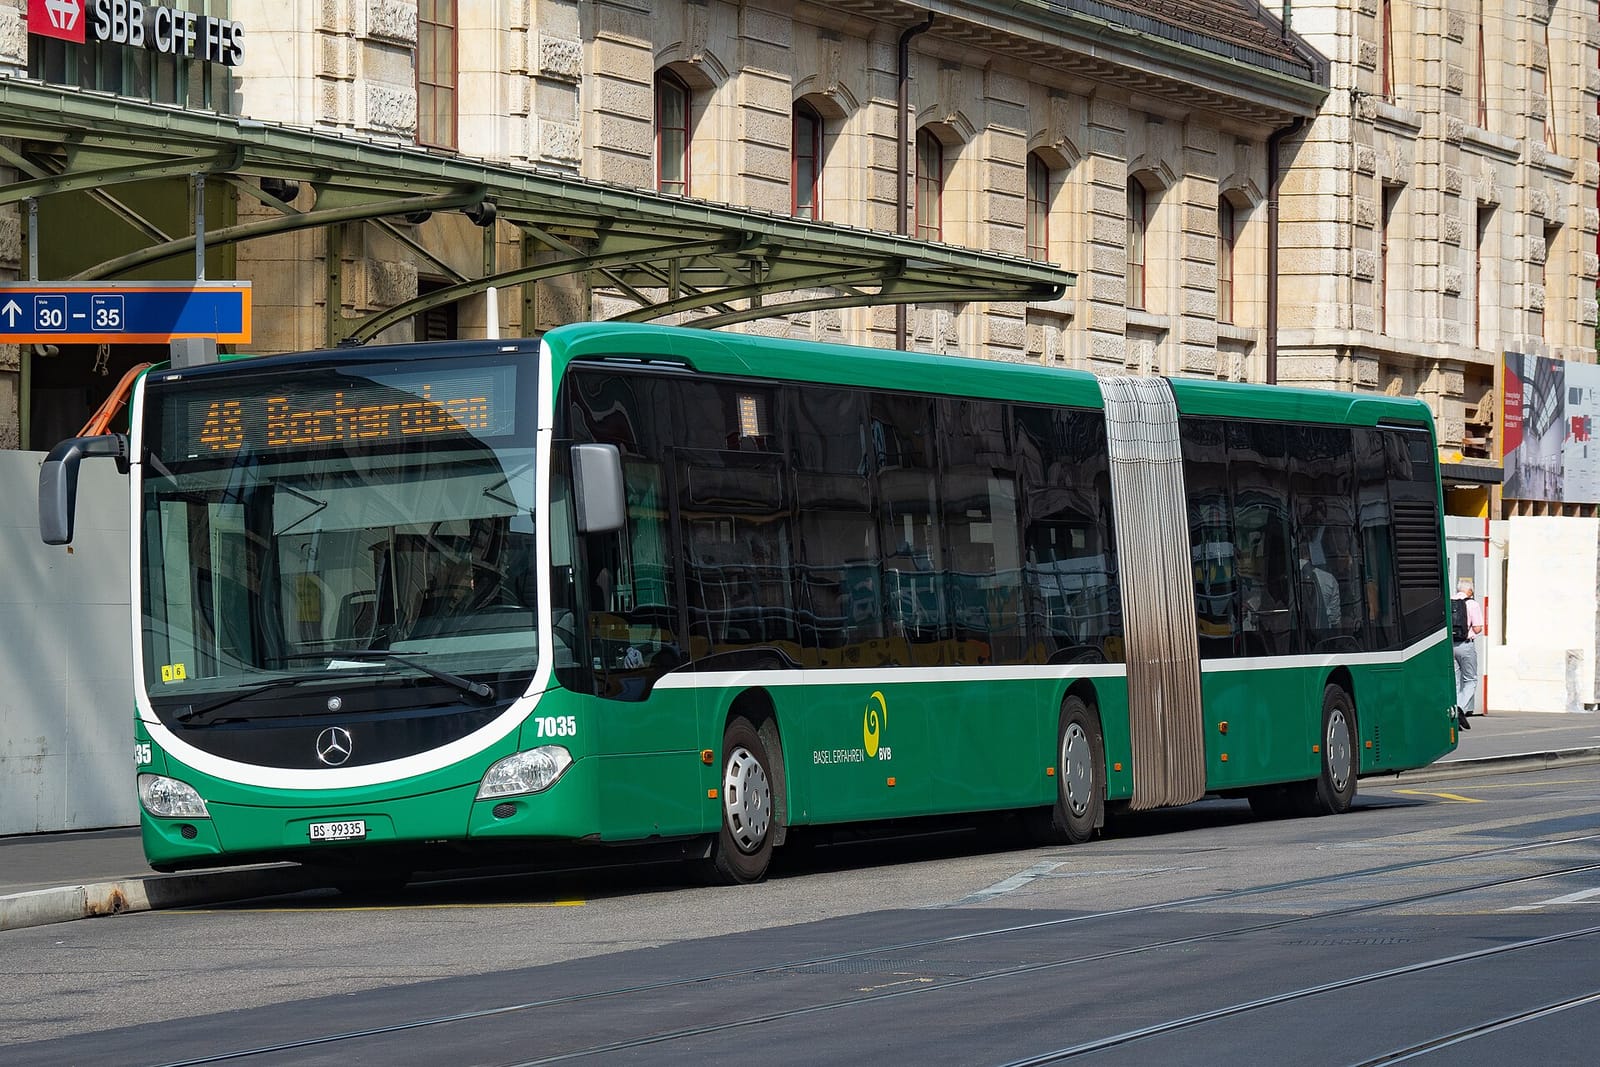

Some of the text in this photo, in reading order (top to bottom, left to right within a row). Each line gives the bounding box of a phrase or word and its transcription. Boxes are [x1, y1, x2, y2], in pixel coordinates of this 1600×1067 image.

[95, 0, 246, 67] SBB CFF FFS
[40, 309, 62, 327] 30
[96, 308, 120, 326] 35
[201, 401, 243, 450] 48
[534, 715, 577, 738] 7035
[135, 743, 151, 764] 35
[813, 749, 864, 764] BASEL ERFAHREN
[878, 747, 892, 761] BVB
